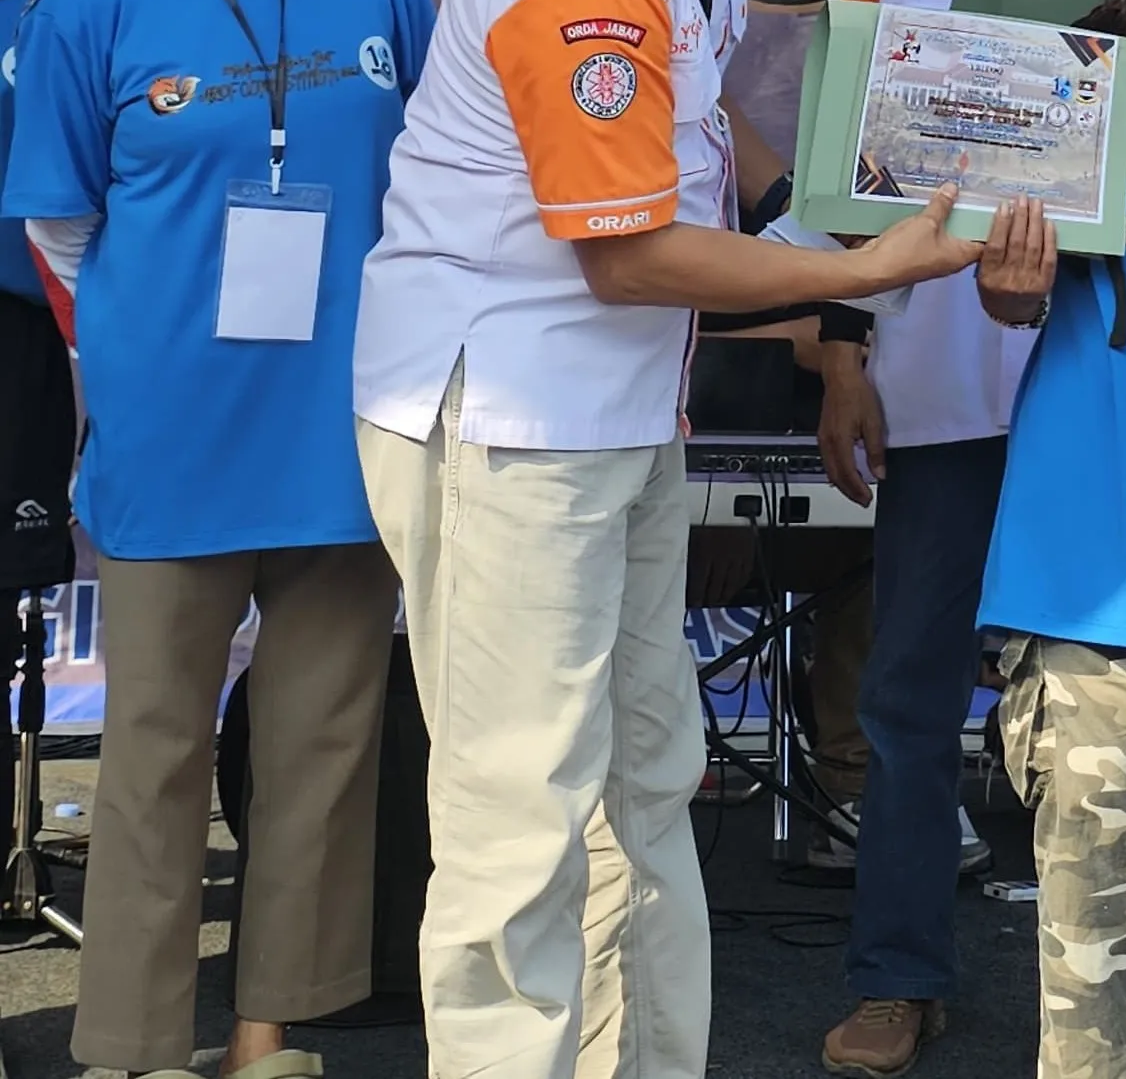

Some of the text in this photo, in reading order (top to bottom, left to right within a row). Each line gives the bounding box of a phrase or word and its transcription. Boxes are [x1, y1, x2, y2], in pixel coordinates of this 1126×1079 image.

[567, 22, 640, 42] ORDA JABAR
[586, 211, 650, 231] ORARI
